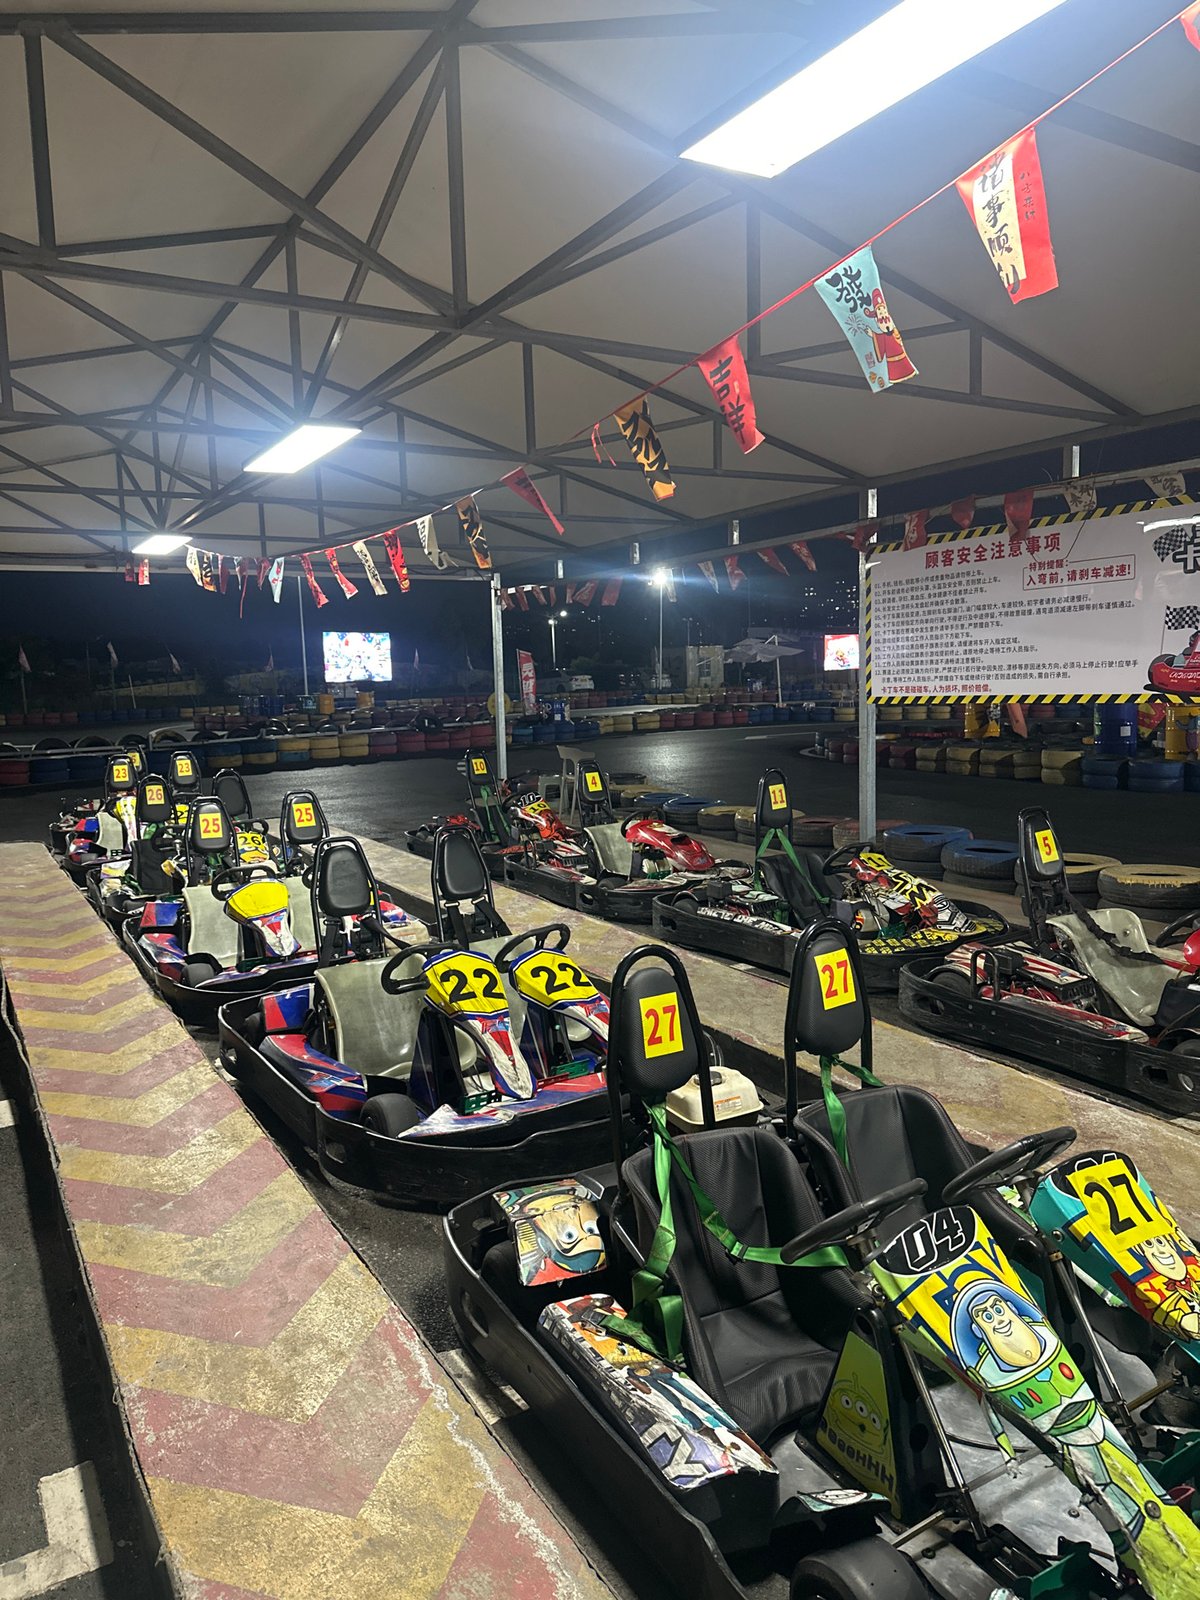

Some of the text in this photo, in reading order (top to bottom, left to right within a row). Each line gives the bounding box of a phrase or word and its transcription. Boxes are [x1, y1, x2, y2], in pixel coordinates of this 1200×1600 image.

[925, 532, 1061, 570] 顾客安全注意事项
[115, 769, 127, 779] 23
[178, 763, 191, 773] 23
[474, 761, 485, 771] 10
[591, 775, 597, 787] 4
[147, 789, 163, 800] 26
[771, 788, 785, 805] 11
[295, 807, 313, 823] 25
[529, 803, 546, 812] 10
[201, 818, 221, 834] 25
[238, 835, 262, 846] 26
[1043, 836, 1052, 856] 5
[440, 967, 505, 1003] 22
[530, 962, 592, 995] 22
[820, 960, 849, 1000] 27
[645, 1004, 678, 1046] 27
[1083, 1173, 1154, 1236] 27
[901, 1208, 966, 1272] 04
